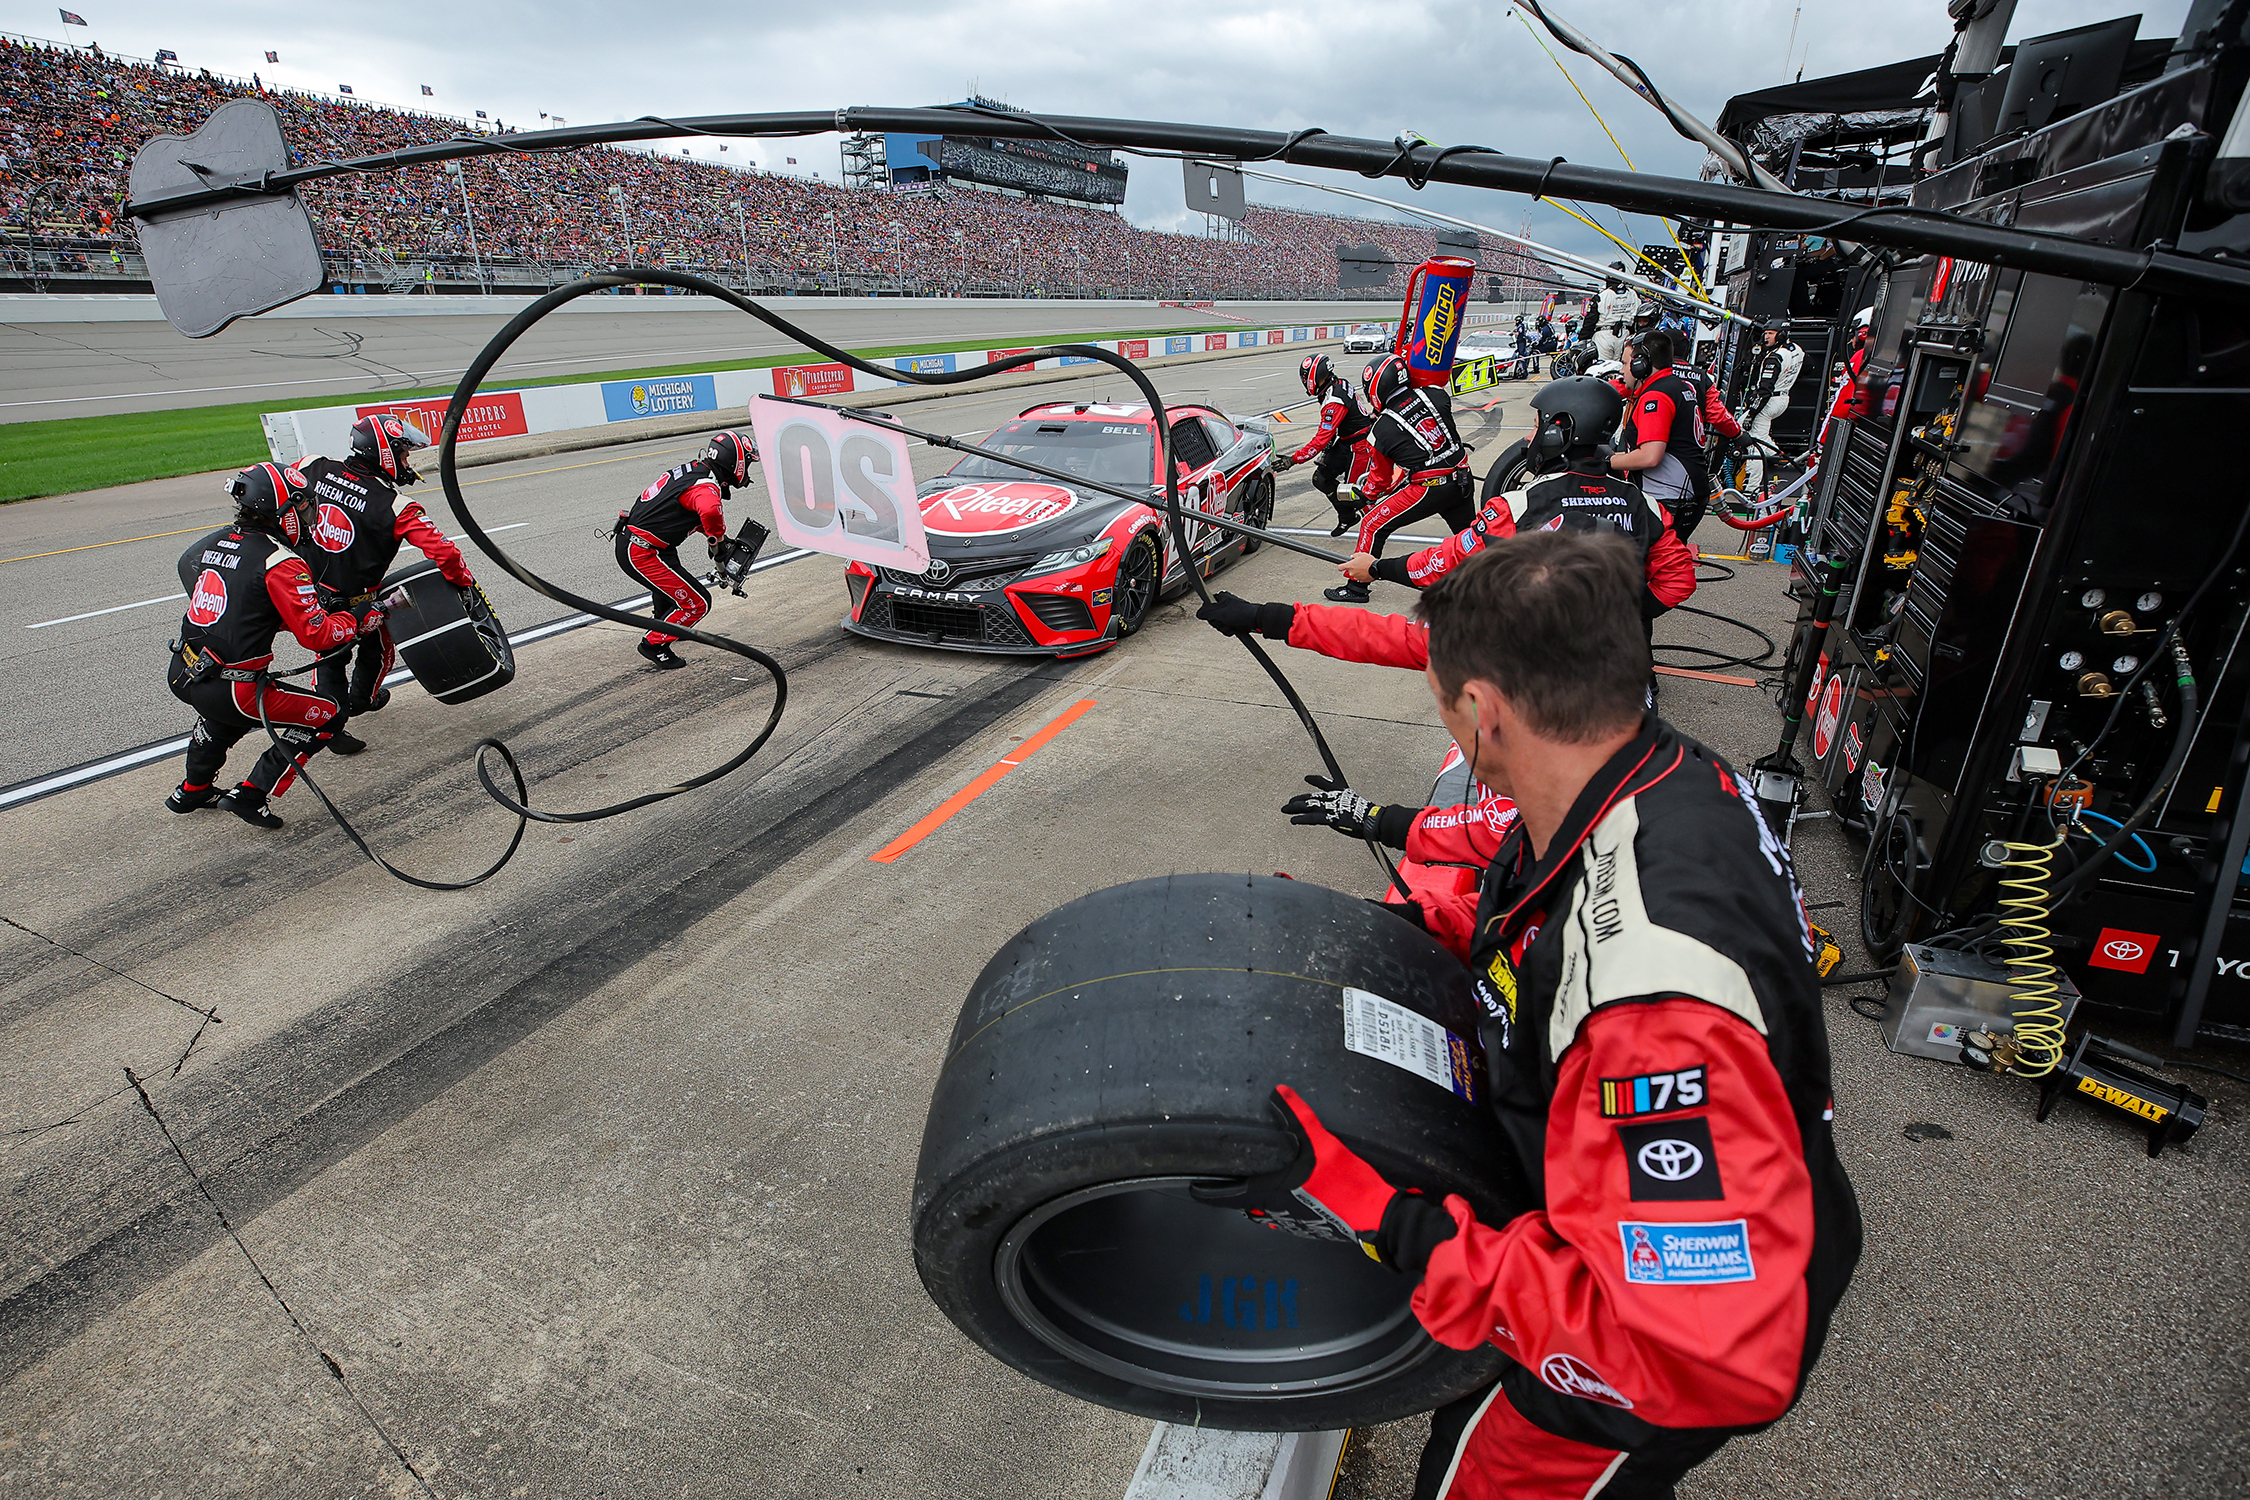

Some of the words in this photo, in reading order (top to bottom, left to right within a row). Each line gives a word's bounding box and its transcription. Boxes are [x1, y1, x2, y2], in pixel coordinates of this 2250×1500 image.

[1428, 287, 1454, 363] SUNOCO
[919, 358, 945, 368] MICHIGAN
[1397, 370, 1408, 382] 20
[1456, 359, 1491, 391] 41
[648, 381, 693, 395] MICHIGAN
[651, 395, 694, 412] LOTTERY
[1102, 425, 1142, 436] BELL
[381, 448, 394, 469] RHEEM
[707, 447, 718, 460] 20
[224, 477, 236, 493] 20
[325, 472, 368, 496] McBEATH
[1580, 486, 1607, 494] TRD
[314, 481, 367, 513] RHEEM.COM
[921, 482, 1050, 521] Rheem
[1561, 497, 1628, 507] SHERWOOD
[285, 511, 297, 535] RHEEM
[316, 504, 351, 546] Rheem
[216, 540, 241, 550] GIBBS
[201, 550, 242, 571] RHEEM.COM
[894, 587, 982, 602] CAMRY
[1420, 809, 1484, 829] RHEEM.COM
[1439, 1037, 1450, 1080] EAGLE
[1650, 1069, 1703, 1110] 75
[2077, 1076, 2169, 1124] DEWALT
[1662, 1234, 1739, 1251] SHERWIN
